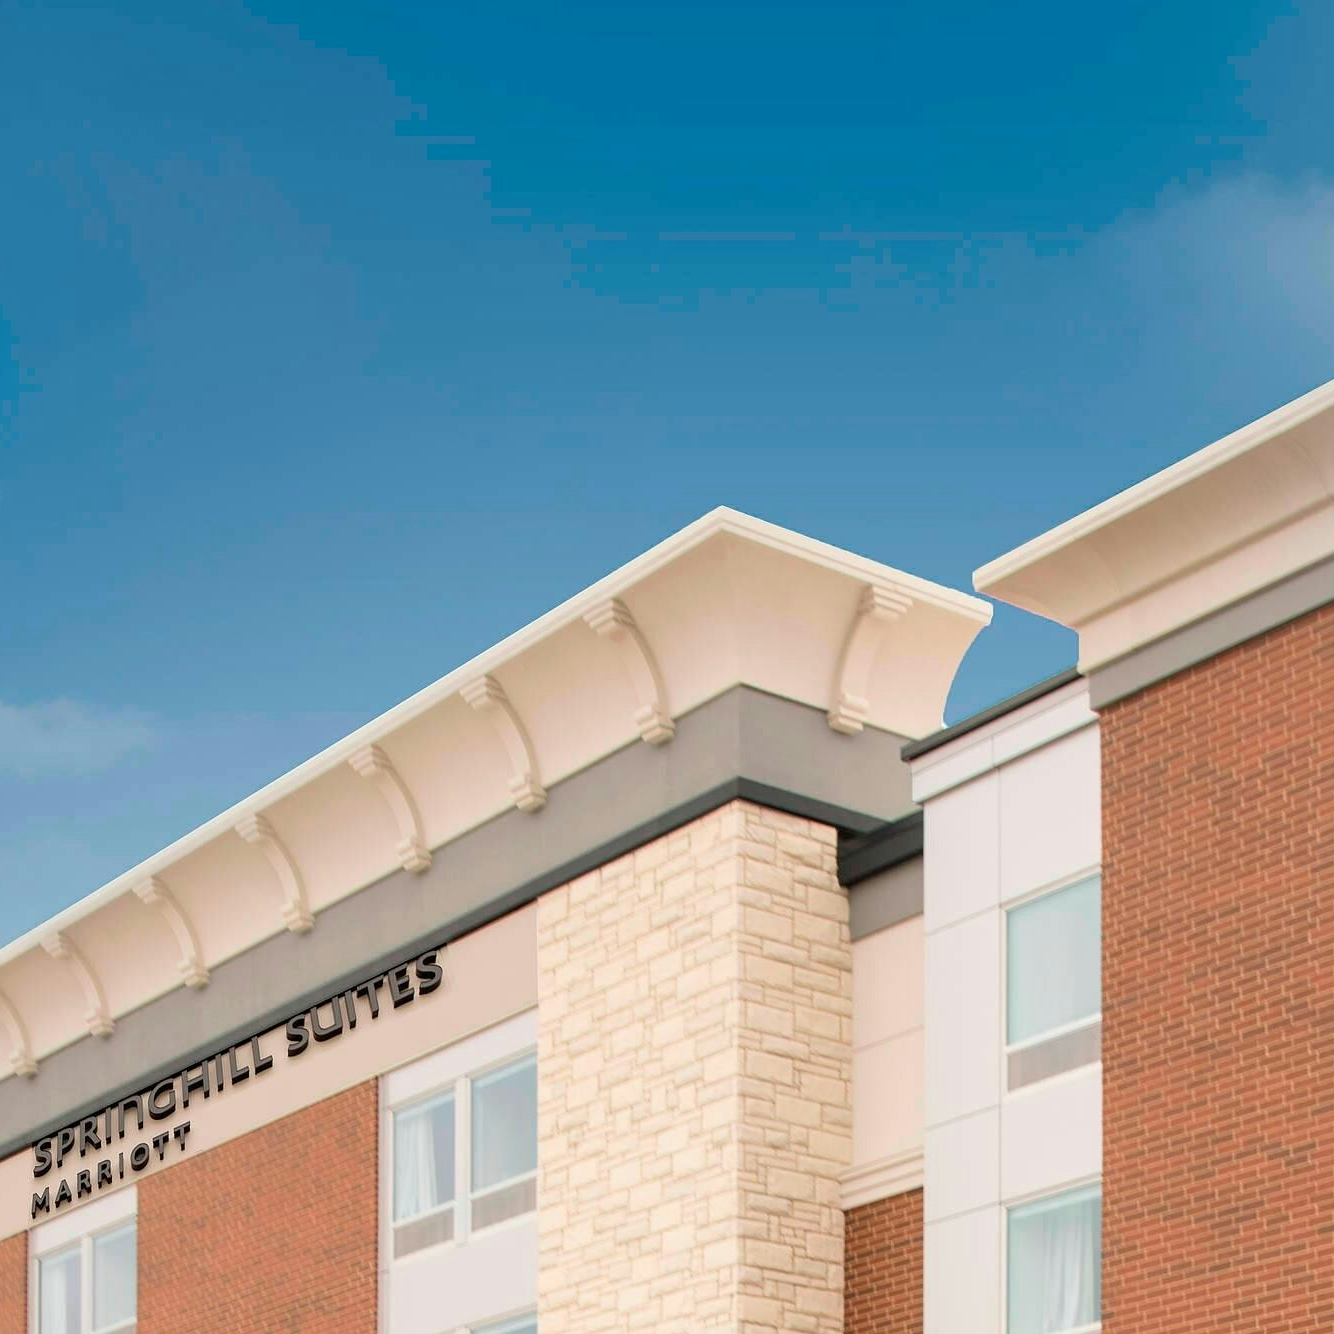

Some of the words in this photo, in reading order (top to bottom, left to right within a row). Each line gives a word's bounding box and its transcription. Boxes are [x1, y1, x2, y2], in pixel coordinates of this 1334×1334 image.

[33, 1036, 273, 1178] SPRINGHILL
[286, 950, 443, 1058] SUITES
[31, 1121, 191, 1219] MARRIOTT
